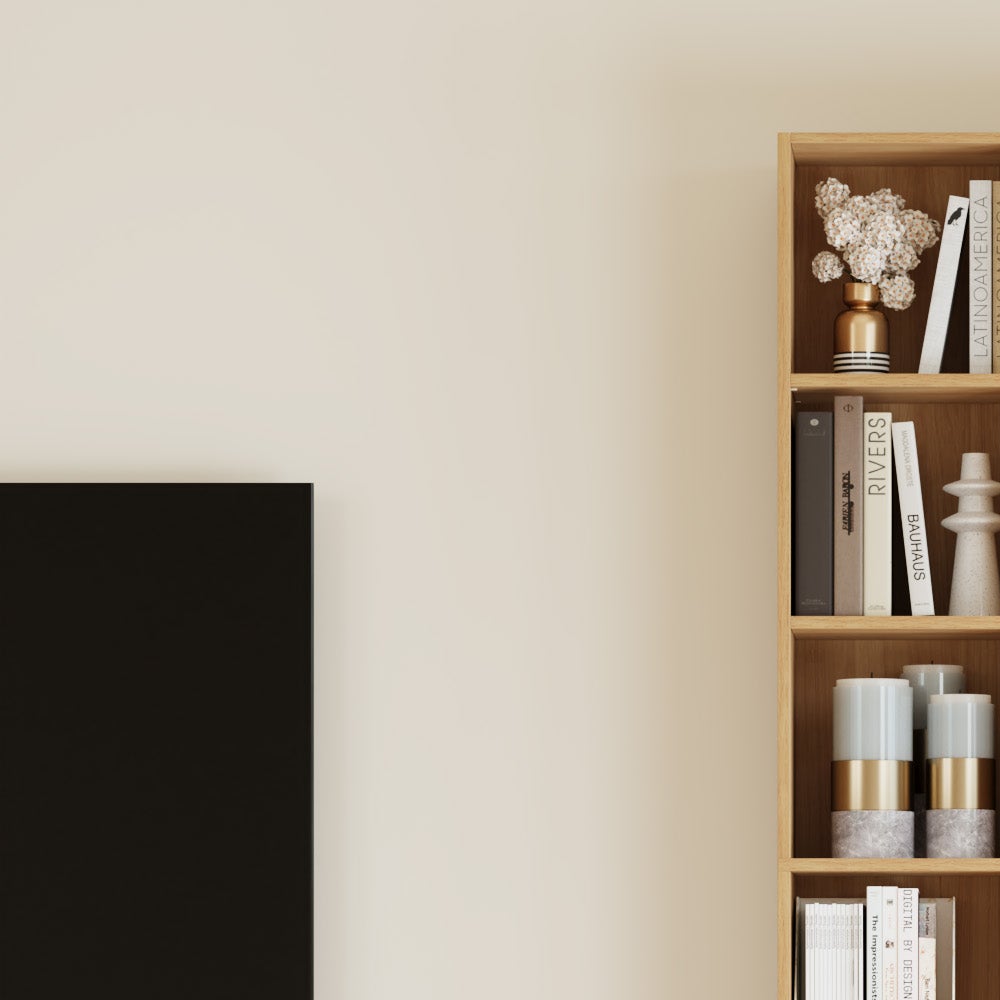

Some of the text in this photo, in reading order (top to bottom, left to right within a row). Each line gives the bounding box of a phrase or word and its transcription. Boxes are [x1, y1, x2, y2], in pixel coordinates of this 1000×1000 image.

[973, 196, 988, 357] LATINOAMERICA
[868, 417, 886, 496] RIVERS
[907, 514, 926, 581] BAUHAUS
[903, 889, 913, 932] DIGITAL
[903, 940, 913, 952] BY
[903, 959, 913, 999] DESIGN
